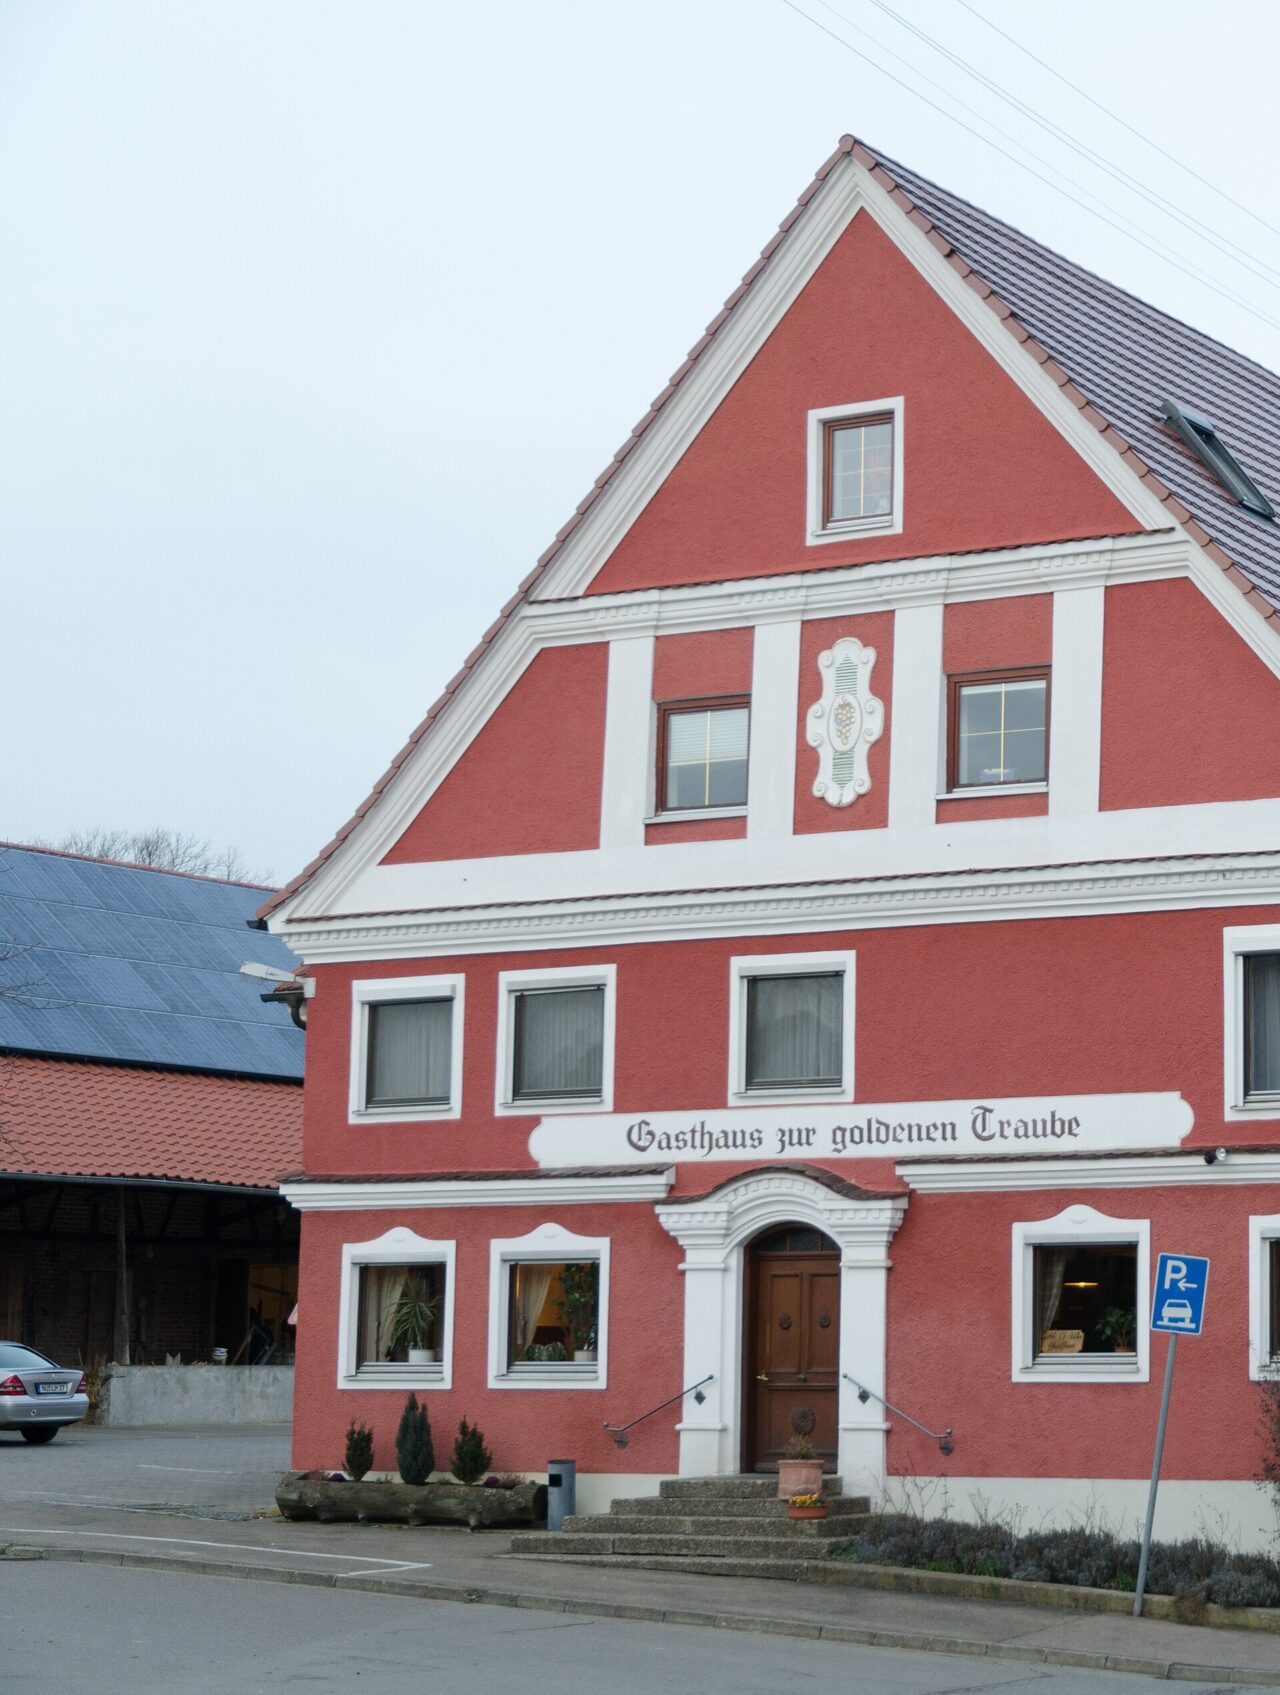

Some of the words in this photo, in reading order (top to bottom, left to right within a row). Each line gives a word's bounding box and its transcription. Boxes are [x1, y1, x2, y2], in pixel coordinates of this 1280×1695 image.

[626, 1119, 763, 1158] Gasthaus
[776, 1126, 816, 1154] zur
[831, 1117, 958, 1154] goldenen
[971, 1105, 1081, 1142] Traube
[1164, 1259, 1188, 1290] P
